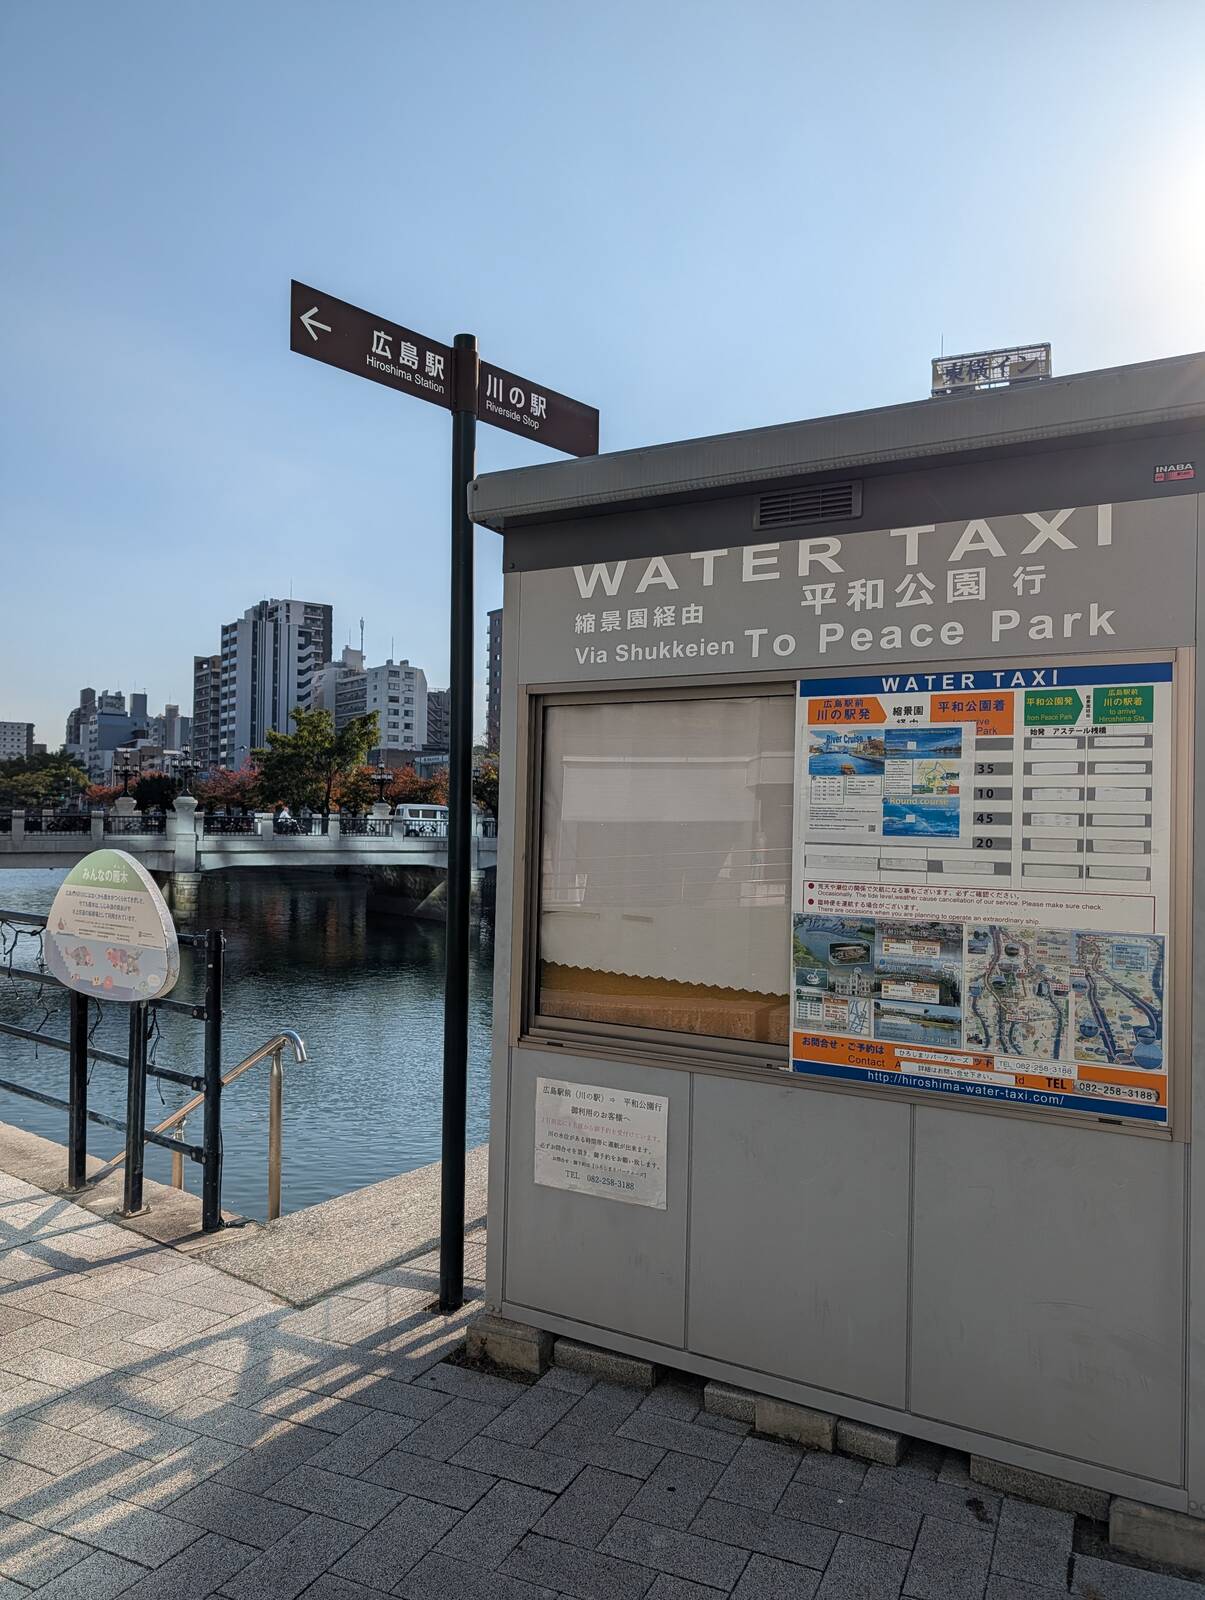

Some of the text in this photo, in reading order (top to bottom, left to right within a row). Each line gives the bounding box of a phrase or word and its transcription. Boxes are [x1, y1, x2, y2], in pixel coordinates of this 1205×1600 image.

[371, 330, 445, 380] 広島駅
[366, 354, 445, 394] Hiroshima Station
[486, 374, 547, 419] 川の駅
[486, 400, 540, 431] Riverside Stop
[1155, 463, 1193, 473] INABA
[573, 503, 1113, 599] WATER TAXI
[801, 565, 1047, 615] 平和公園 行
[574, 603, 704, 634] 縮景園経由
[575, 603, 1117, 664] Via Shukkeien To Peace Park
[882, 669, 1058, 692] WATER TAXI
[823, 699, 864, 708] 広島駅前
[938, 700, 1006, 712] 平和公園着
[1027, 696, 1073, 707] 平和公園発
[1103, 697, 1144, 706] 川の駅着
[817, 708, 871, 721] 川の駅発
[893, 705, 924, 716] 縮景園
[1030, 728, 1045, 736] 始発
[826, 733, 864, 745] River Cruise
[977, 763, 994, 774] 35
[977, 788, 994, 799] 10
[890, 797, 918, 806] Round
[977, 813, 994, 824] 45
[977, 838, 993, 849] 20
[1021, 900, 1044, 908] Please
[914, 912, 940, 920] planning
[802, 1037, 885, 1055] お問合せ・ご予約は
[847, 1054, 886, 1067] Contact
[867, 1070, 1065, 1105] http://hiroshima-water-taxi.com/
[1046, 1077, 1068, 1090] TEL
[1079, 1080, 1153, 1101] 082-258-3188
[565, 1169, 635, 1190] TEL 082-258-3188
